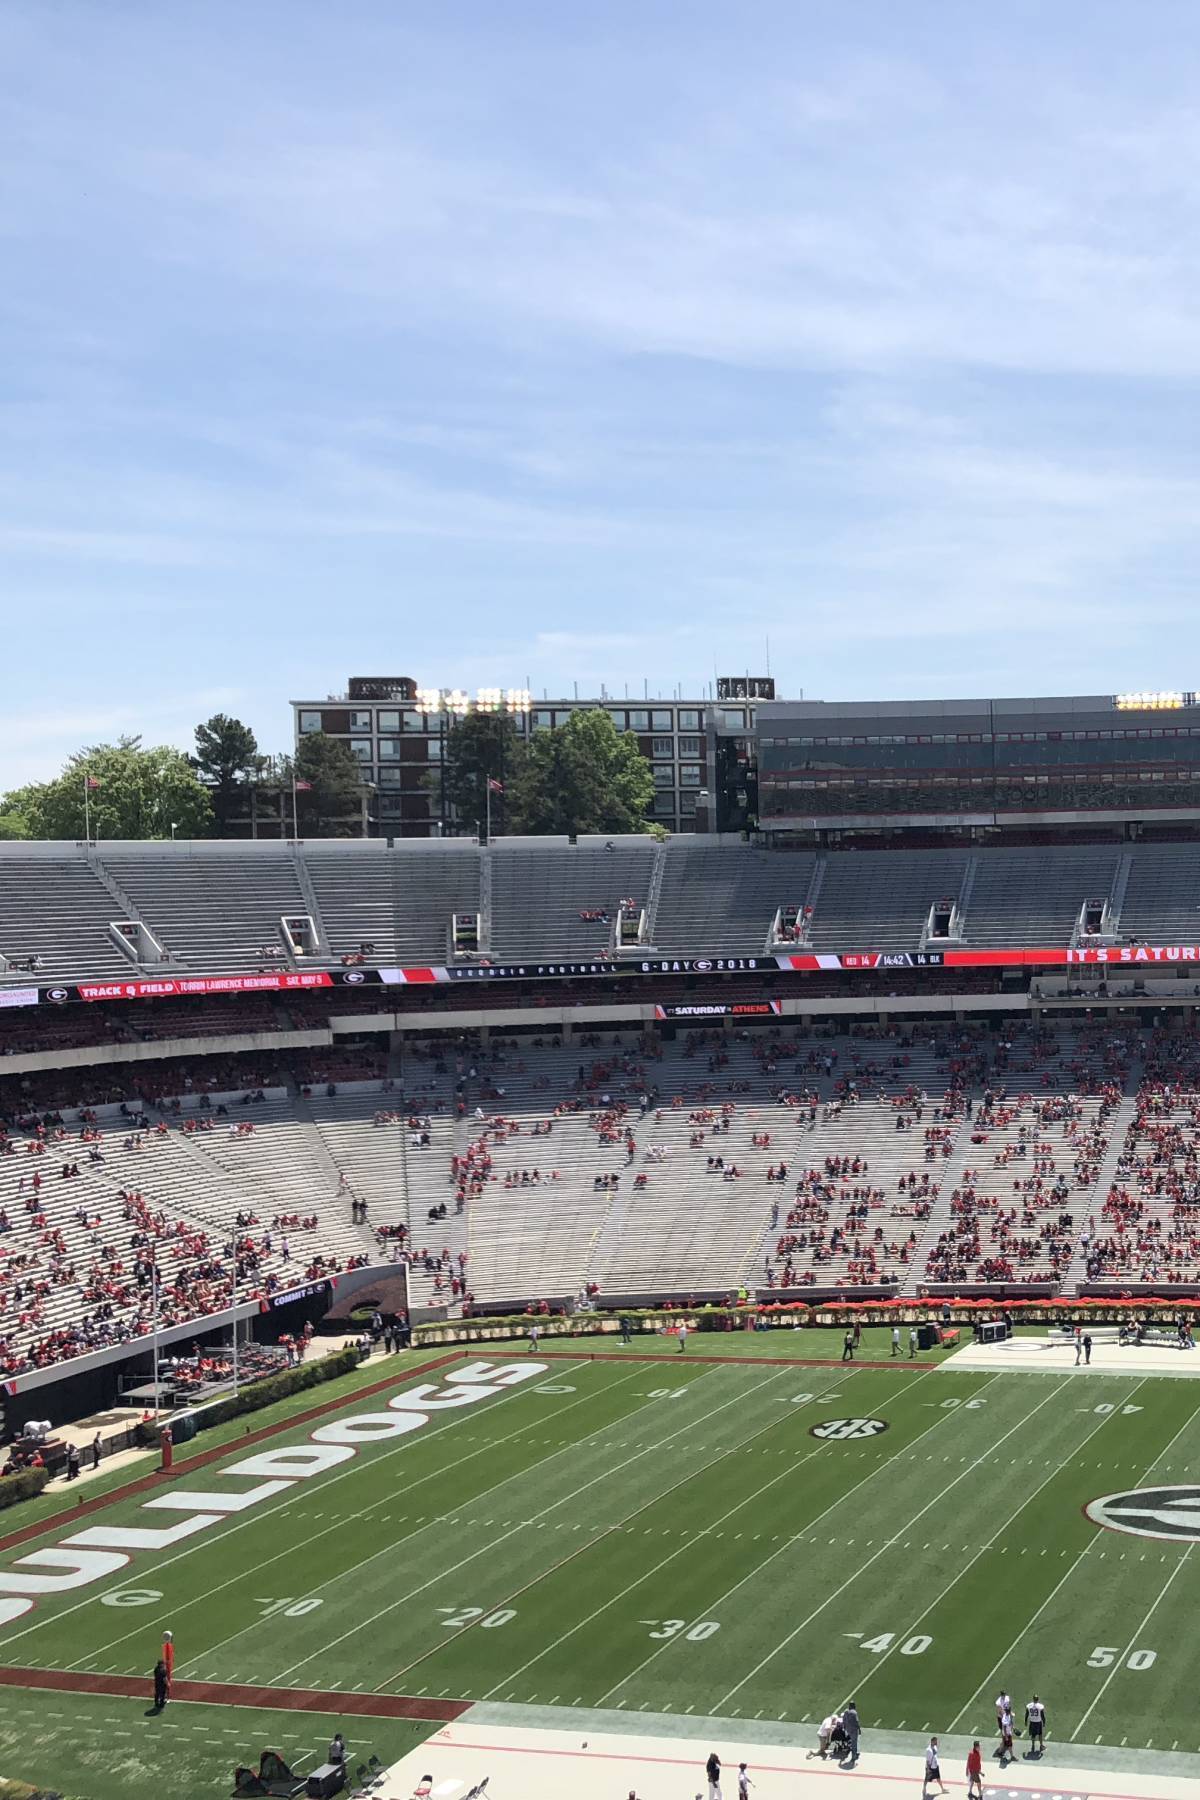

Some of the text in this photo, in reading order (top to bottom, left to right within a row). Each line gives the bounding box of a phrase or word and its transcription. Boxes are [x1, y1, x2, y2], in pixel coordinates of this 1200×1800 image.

[861, 956, 870, 965] 14
[883, 956, 904, 965] 14:42
[917, 955, 926, 964] 14
[1066, 949, 1108, 962] IT'S
[538, 964, 617, 975] FOOTBALL
[642, 961, 690, 972] G-DAY
[717, 959, 756, 969] 2018
[207, 978, 243, 990] LAWRENCE
[243, 976, 280, 989] MEMORIAL
[301, 974, 316, 985] MAY
[82, 982, 173, 997] TRACK & FIELD
[675, 1006, 726, 1015] SATURDAY
[732, 1005, 769, 1014] ATHENS
[274, 1290, 306, 1306] COMMIT
[646, 1388, 688, 1398] 10
[790, 1393, 843, 1404] 20
[938, 1398, 988, 1409] 30
[1093, 1404, 1145, 1415] 40
[812, 1418, 885, 1439] SEC
[0, 1362, 549, 1625] ULLDOGS
[259, 1597, 324, 1617] 10
[440, 1607, 517, 1627] 20
[649, 1619, 721, 1641] 30
[859, 1633, 933, 1655] 40
[1086, 1647, 1158, 1670] 50
[1029, 1708, 1039, 1717] 99
